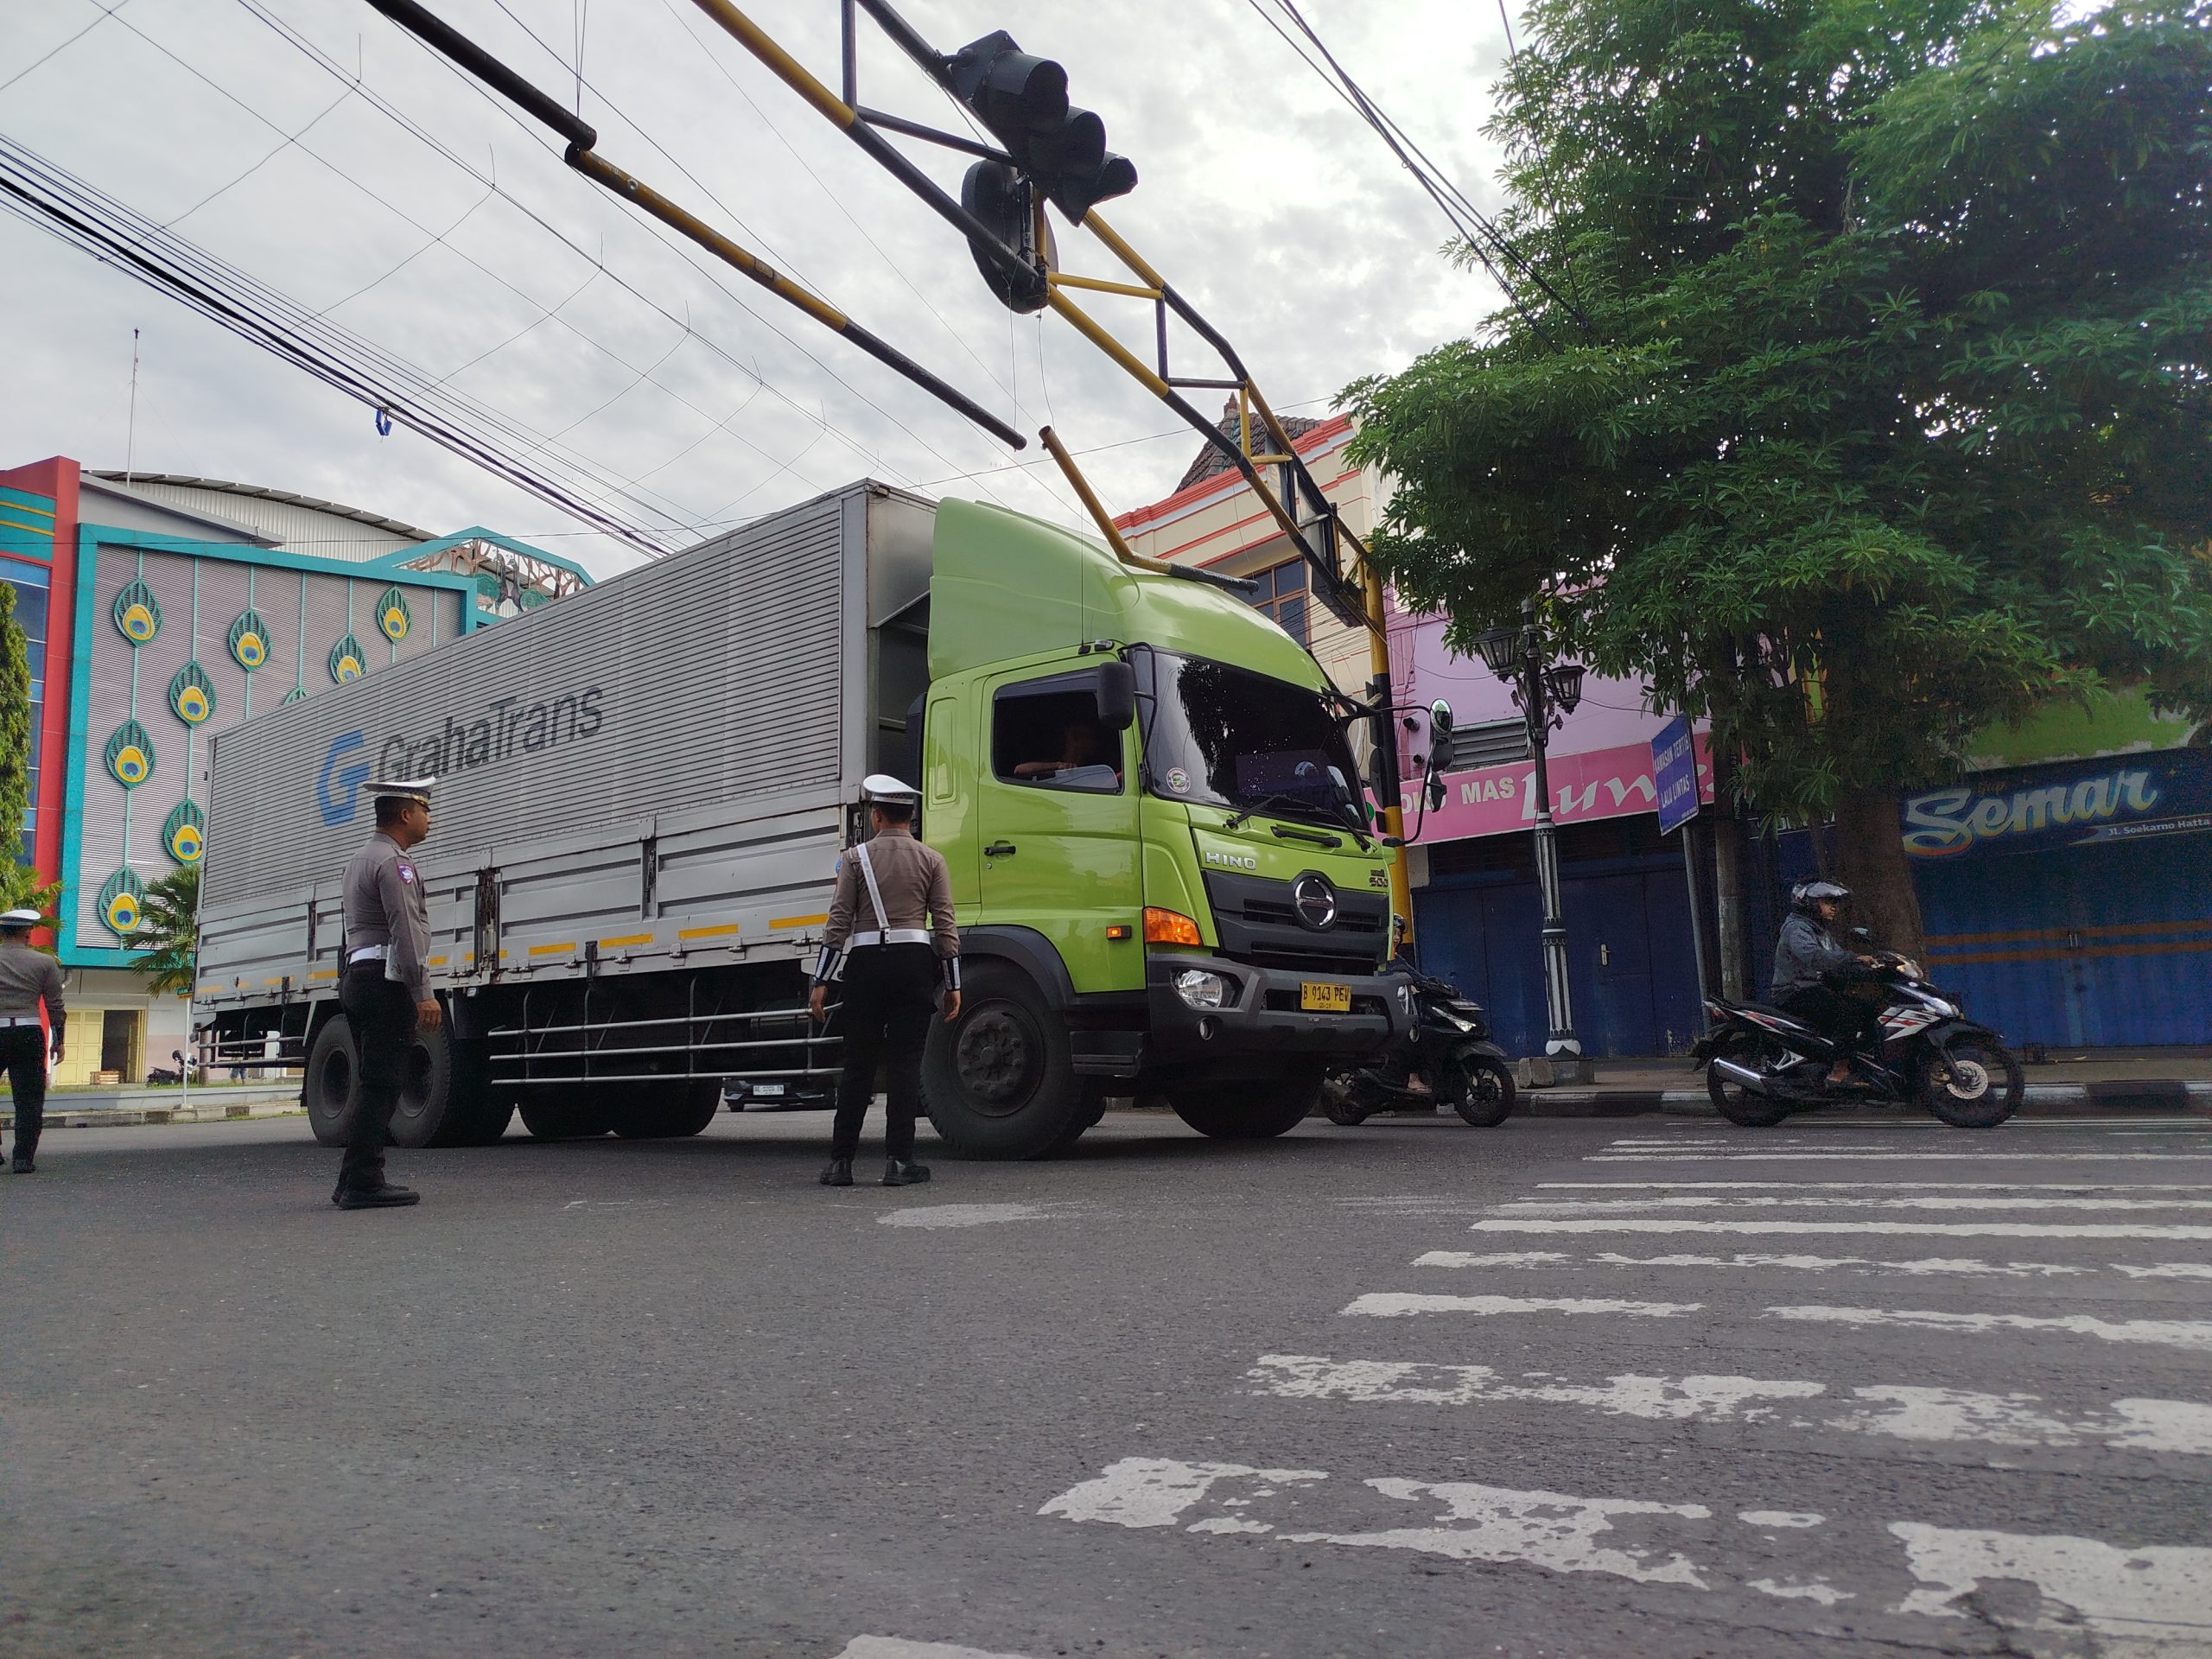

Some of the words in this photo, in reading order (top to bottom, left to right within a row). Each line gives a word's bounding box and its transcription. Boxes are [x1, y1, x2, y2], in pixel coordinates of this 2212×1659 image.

[378, 685, 604, 783] GrahaTrans
[1460, 776, 1516, 804] MAS
[1660, 787, 1673, 810] LALU
[1672, 773, 1690, 800] LINTAS
[1902, 770, 2158, 857] Semar
[2123, 822, 2176, 835] Soekarno
[2177, 817, 2210, 829] Hatta
[1205, 851, 1257, 871] HINO
[1368, 876, 1389, 888] 500
[1303, 984, 1308, 1001] B
[1312, 985, 1331, 1001] 9143
